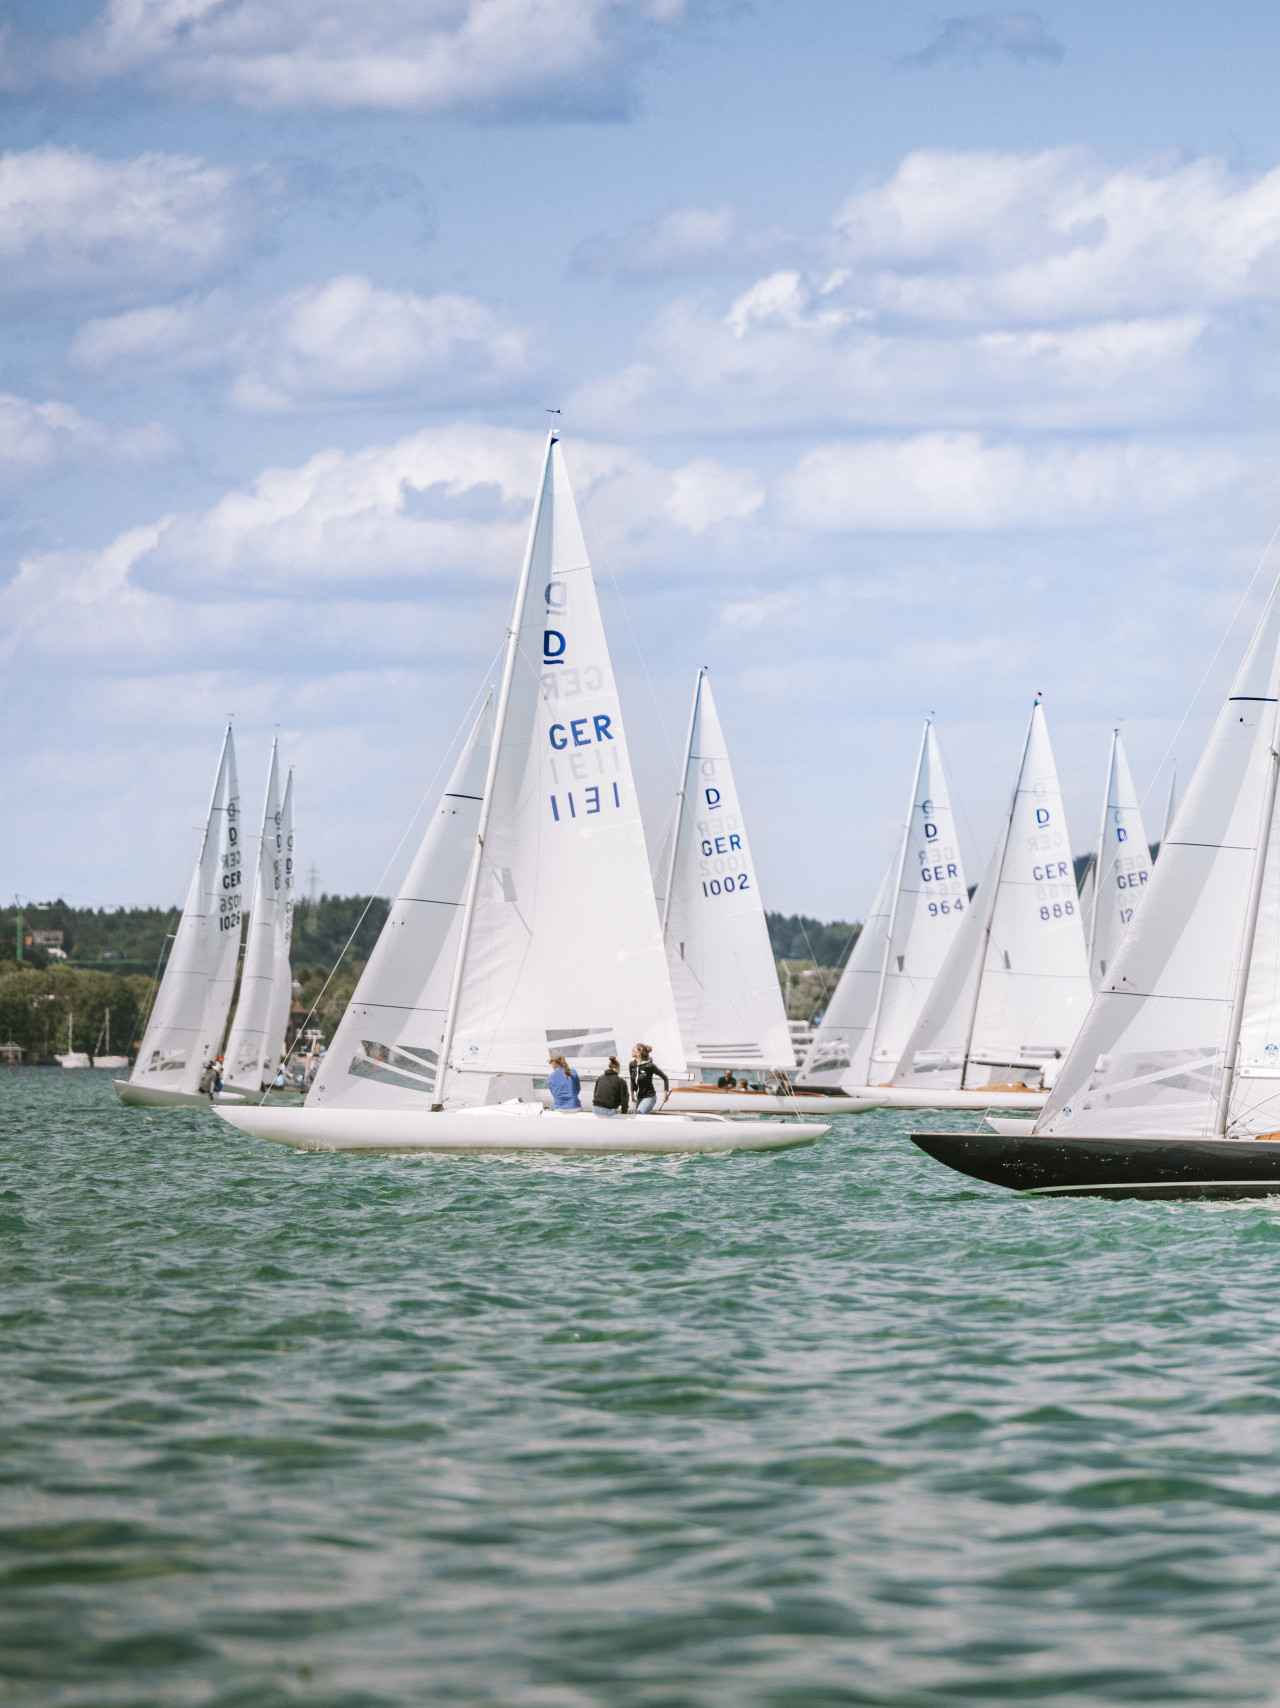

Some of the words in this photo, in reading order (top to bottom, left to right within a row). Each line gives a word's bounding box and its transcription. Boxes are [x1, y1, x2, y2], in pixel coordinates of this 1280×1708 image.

[543, 630, 566, 664] D
[549, 714, 614, 750] GER
[705, 788, 721, 809] D
[1036, 808, 1050, 828] D
[925, 823, 938, 843] D
[701, 834, 742, 856] GER
[223, 871, 240, 889] GER
[921, 864, 957, 881] GER
[1033, 861, 1067, 881] GER
[1117, 871, 1148, 889] GER
[703, 874, 749, 897] 1002
[928, 898, 963, 917] 964
[1040, 900, 1074, 920] 888
